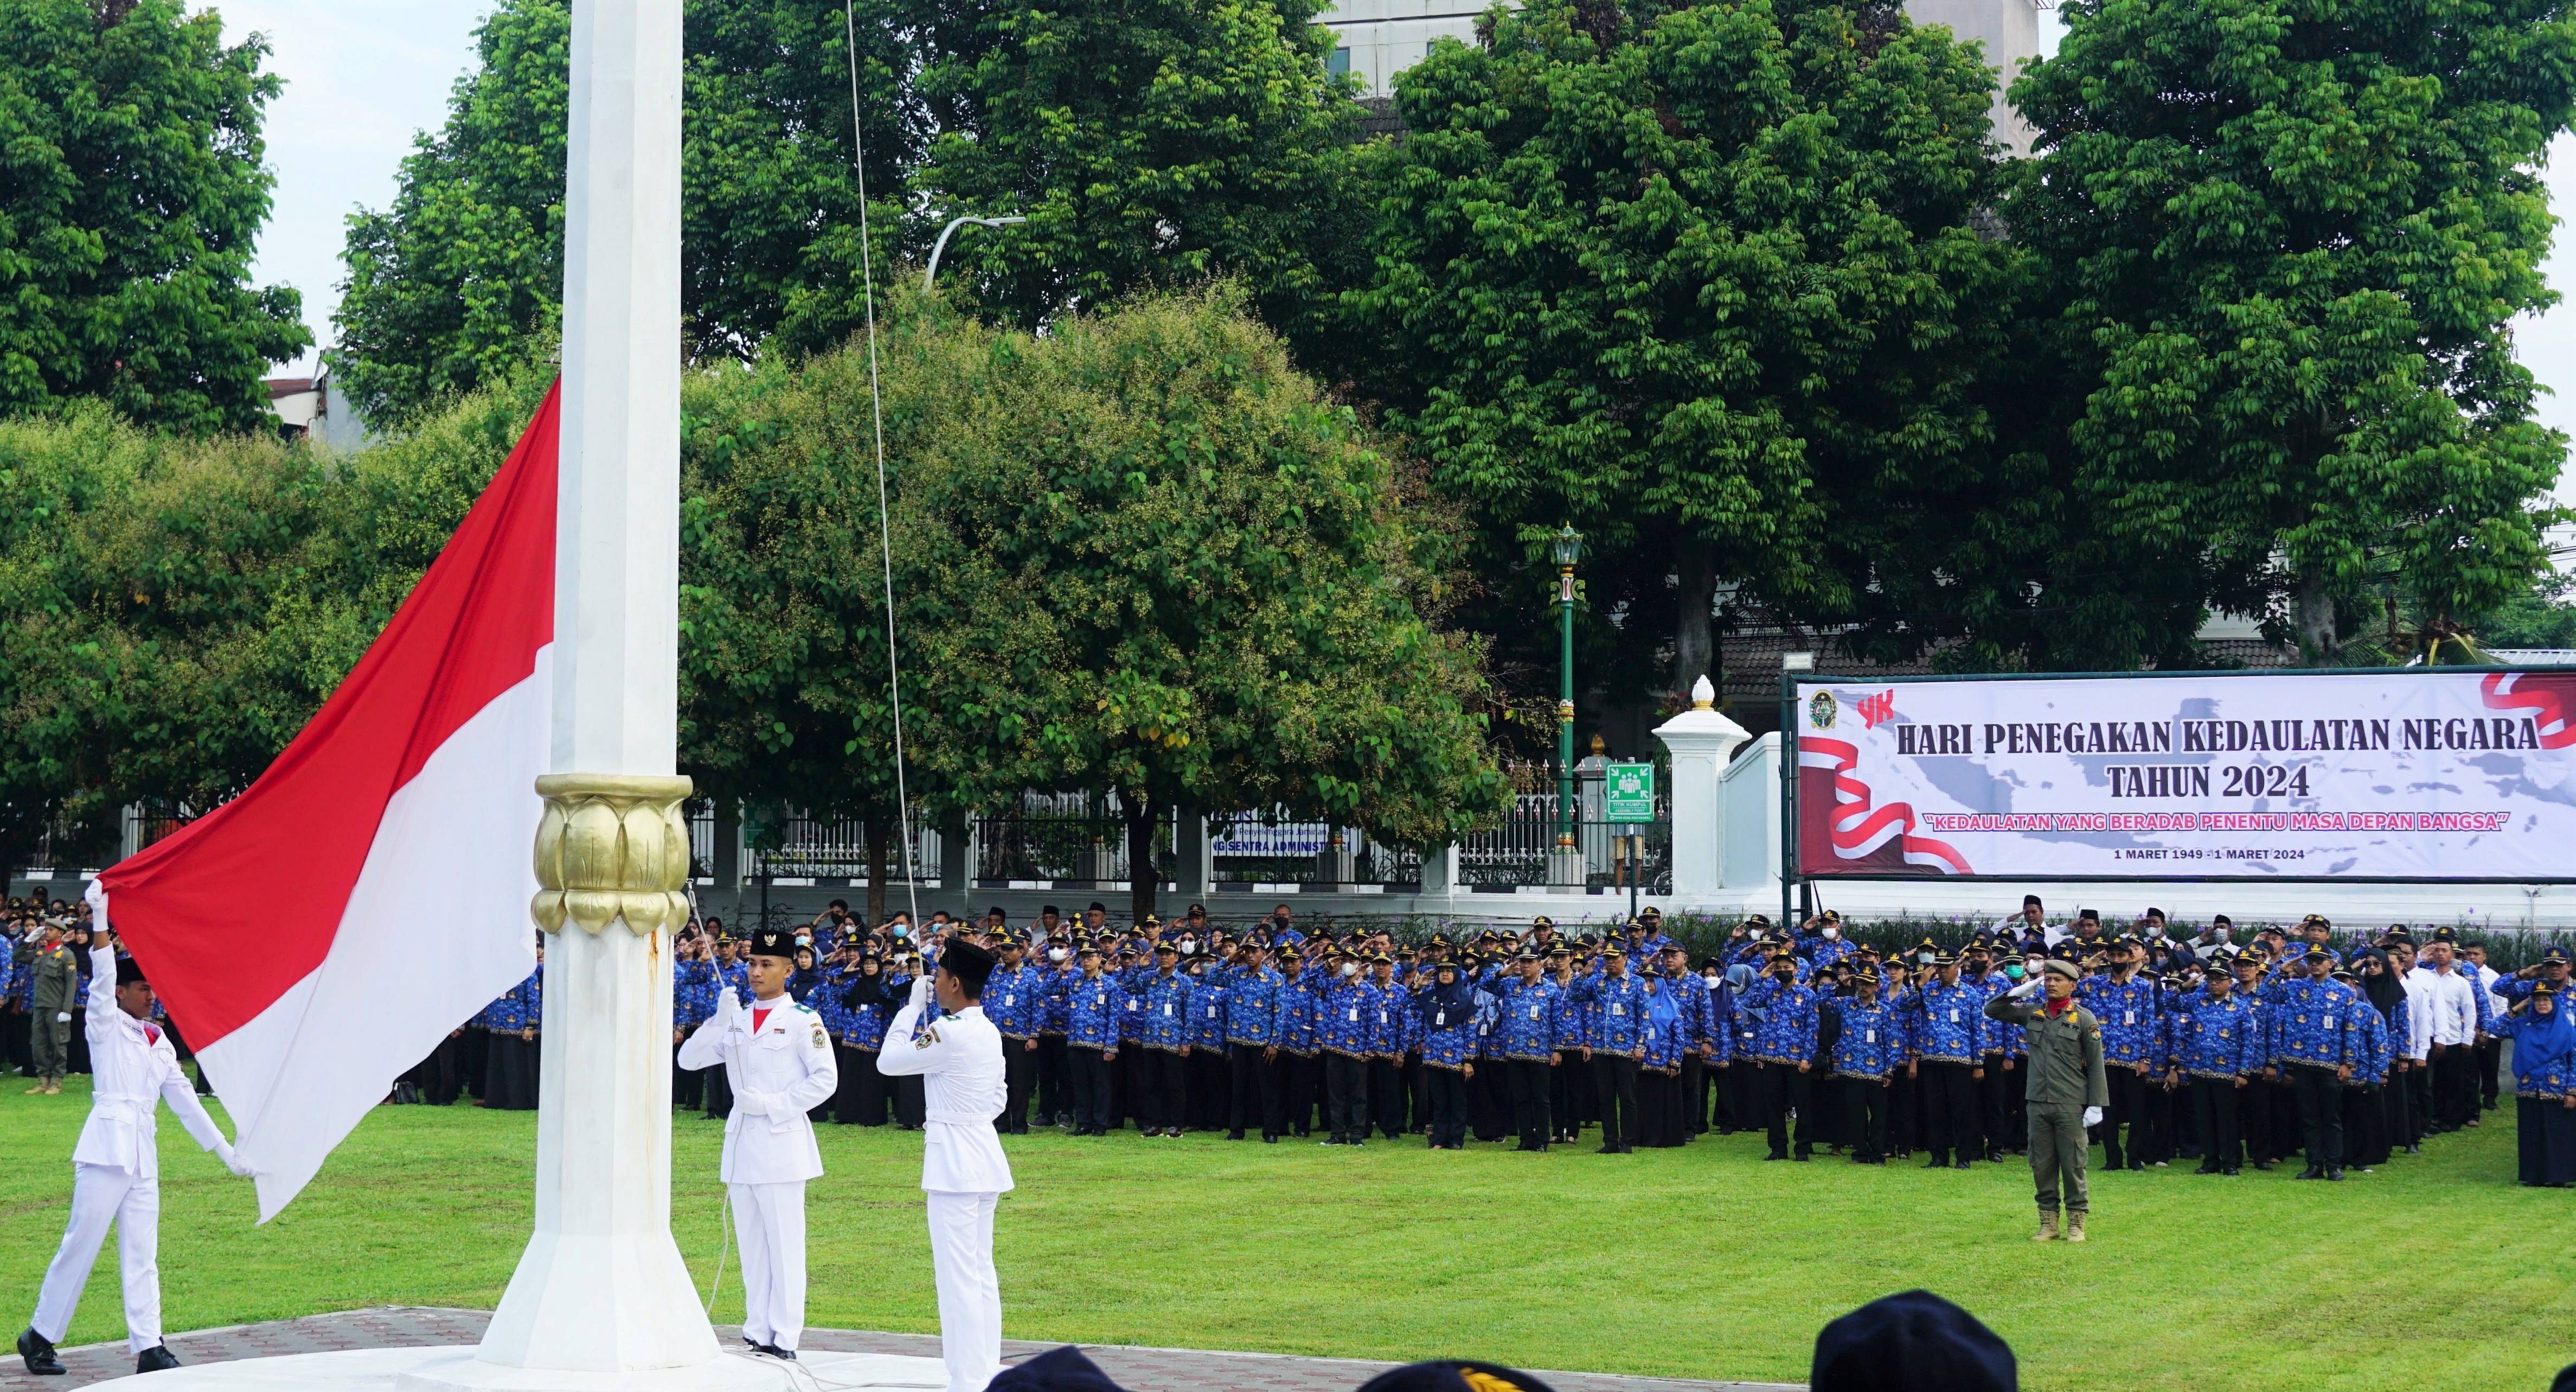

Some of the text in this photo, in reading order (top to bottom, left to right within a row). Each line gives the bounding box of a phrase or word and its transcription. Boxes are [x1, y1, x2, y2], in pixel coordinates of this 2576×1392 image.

[1898, 717, 2539, 754] HARI PENEGAKAN KEDAULATAN NEGARA
[2107, 766, 2309, 797] TAHUN 2024
[2056, 815, 2105, 829] YANG
[2111, 815, 2195, 829] BERADAB
[2201, 815, 2285, 829] PENENTU
[2292, 815, 2343, 829] MASA
[2350, 815, 2413, 829] DEPAN
[1228, 841, 1270, 851] SENTRA
[2114, 850, 2122, 859] 1
[2126, 850, 2168, 859] MARET
[2173, 850, 2203, 859] 1949
[2215, 850, 2222, 859] 1
[2227, 850, 2269, 859] MARET
[2273, 850, 2305, 859] 2024
